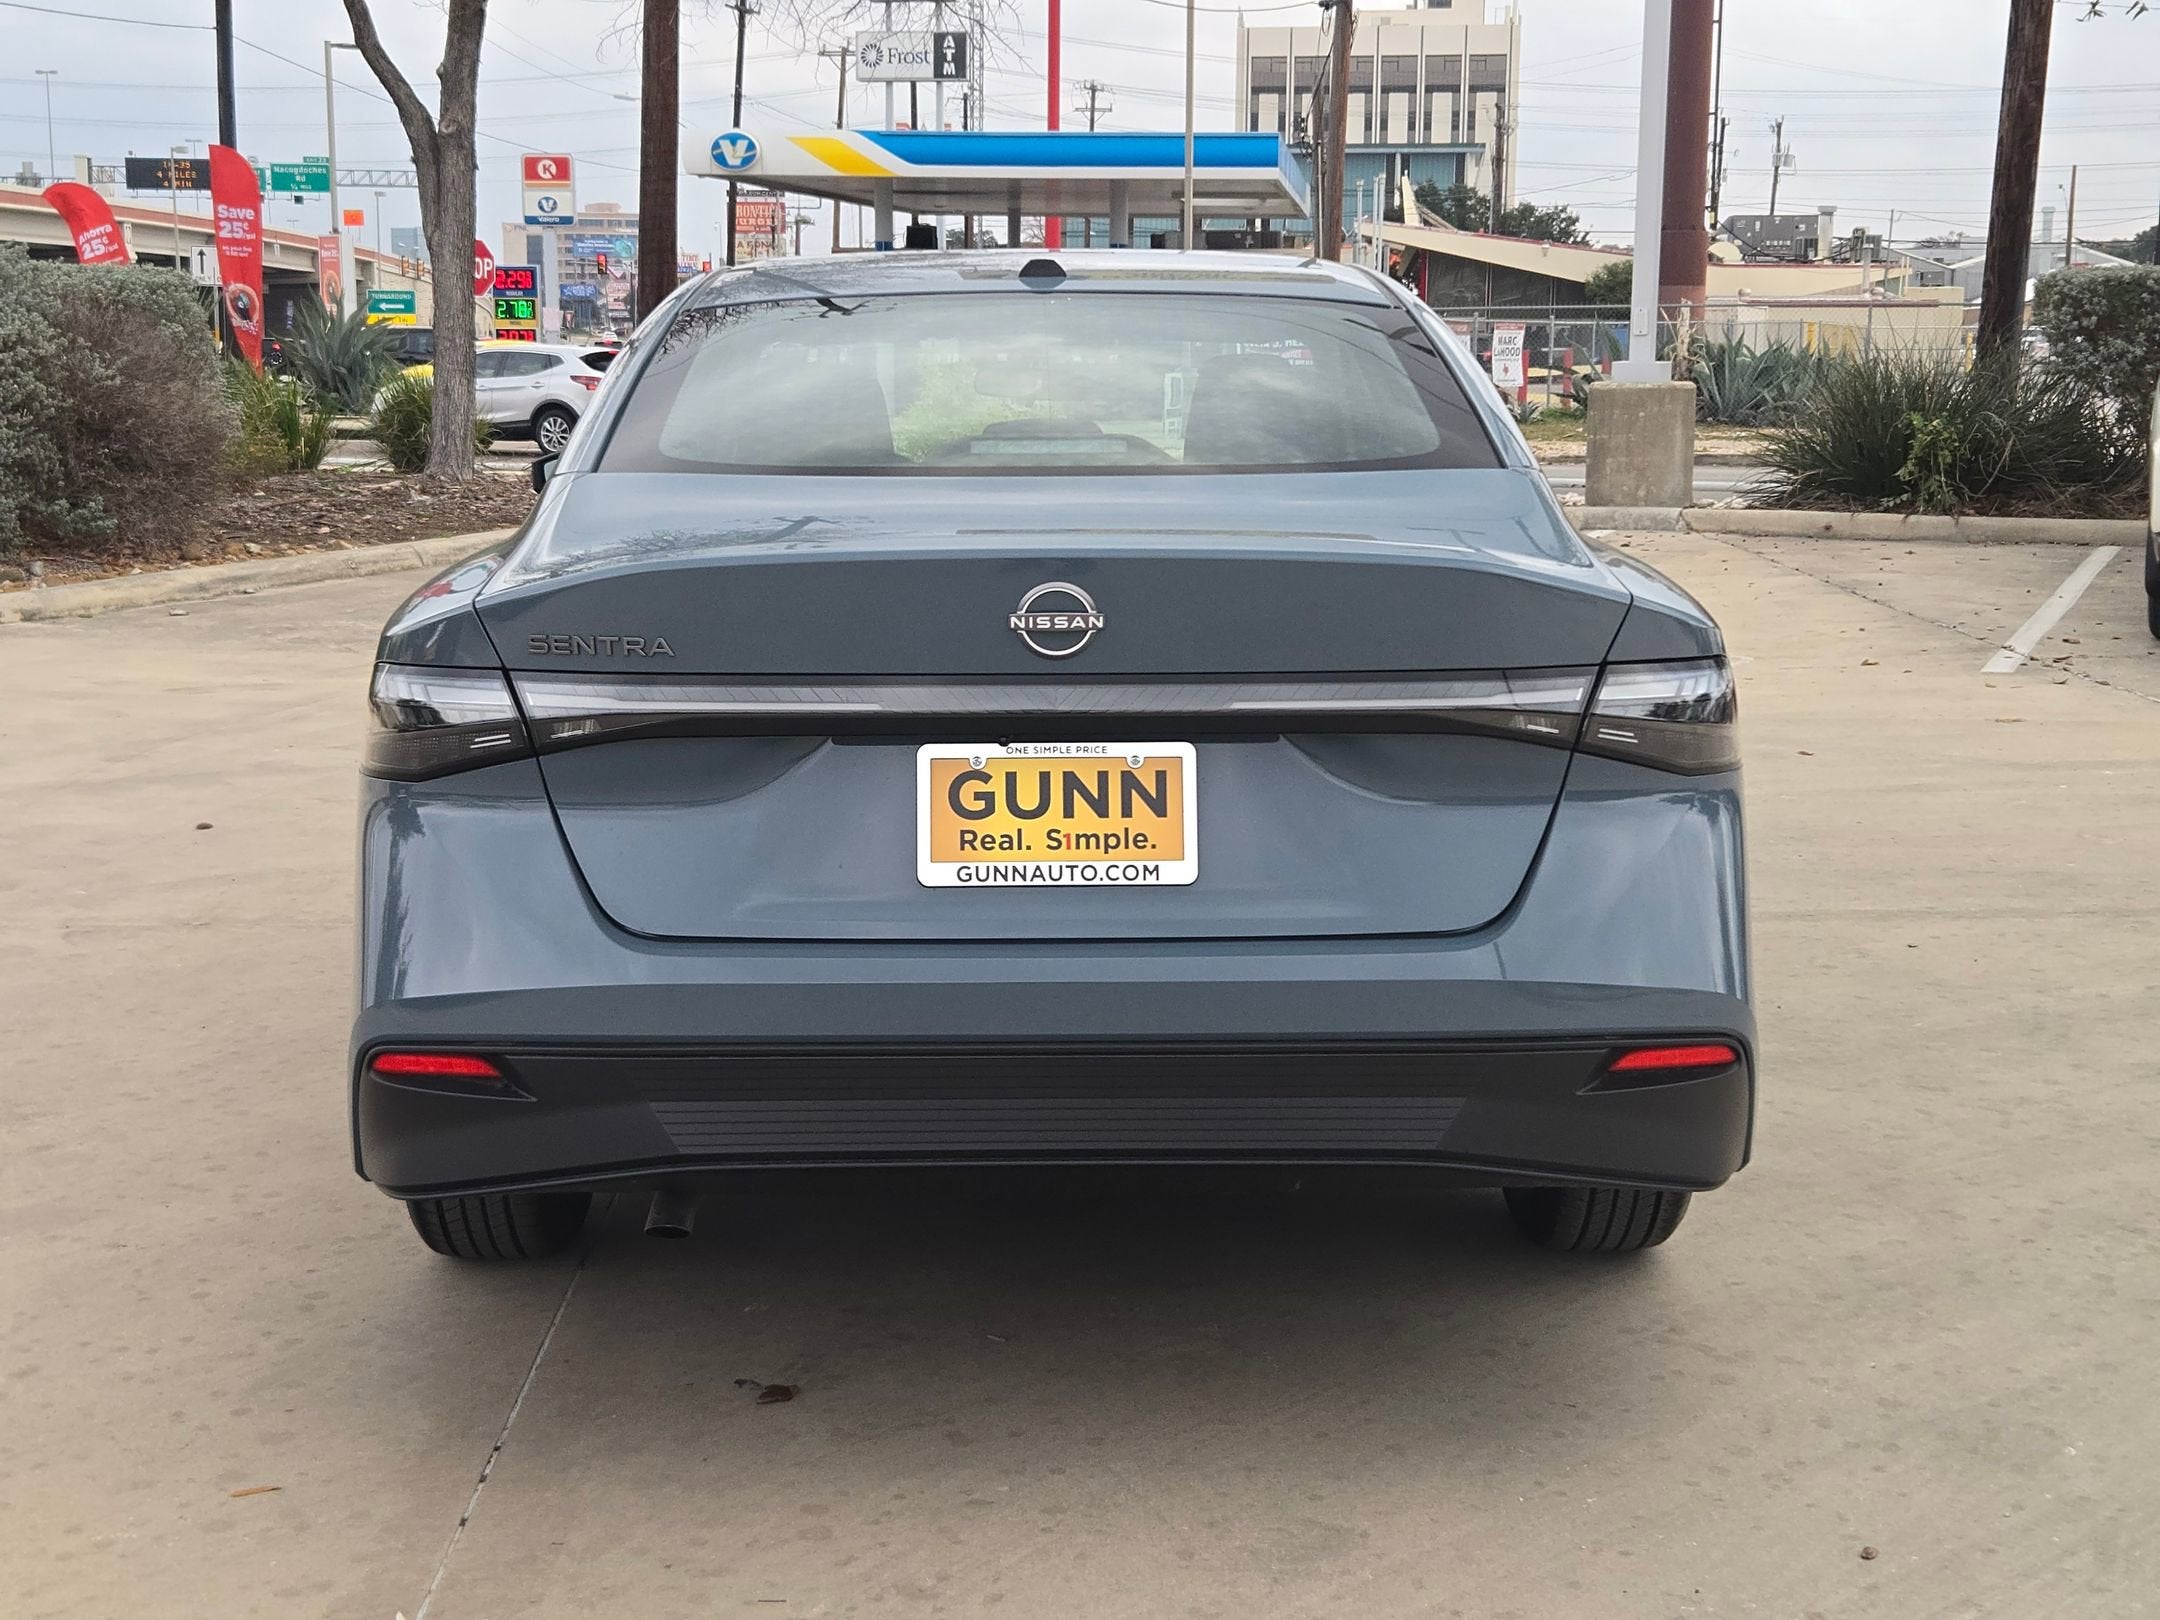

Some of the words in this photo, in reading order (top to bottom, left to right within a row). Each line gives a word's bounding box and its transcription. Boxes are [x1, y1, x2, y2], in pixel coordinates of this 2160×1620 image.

[887, 47, 932, 65] Frost
[943, 34, 956, 76] ATM
[273, 166, 327, 174] Nacogdoches
[217, 204, 256, 220] Save
[79, 224, 113, 246] Ahorra
[475, 257, 493, 280] OP
[1498, 336, 1518, 345] MARC
[1010, 616, 1104, 629] NISSAN
[527, 634, 676, 657] SENTRA
[1006, 746, 1029, 755] ONE
[1033, 746, 1072, 755] SIMPLE
[1076, 745, 1108, 754] PRICE
[948, 769, 1168, 820] GUNN
[959, 828, 1032, 851] Real.
[957, 864, 1160, 882] GUNNAUTO.COM
